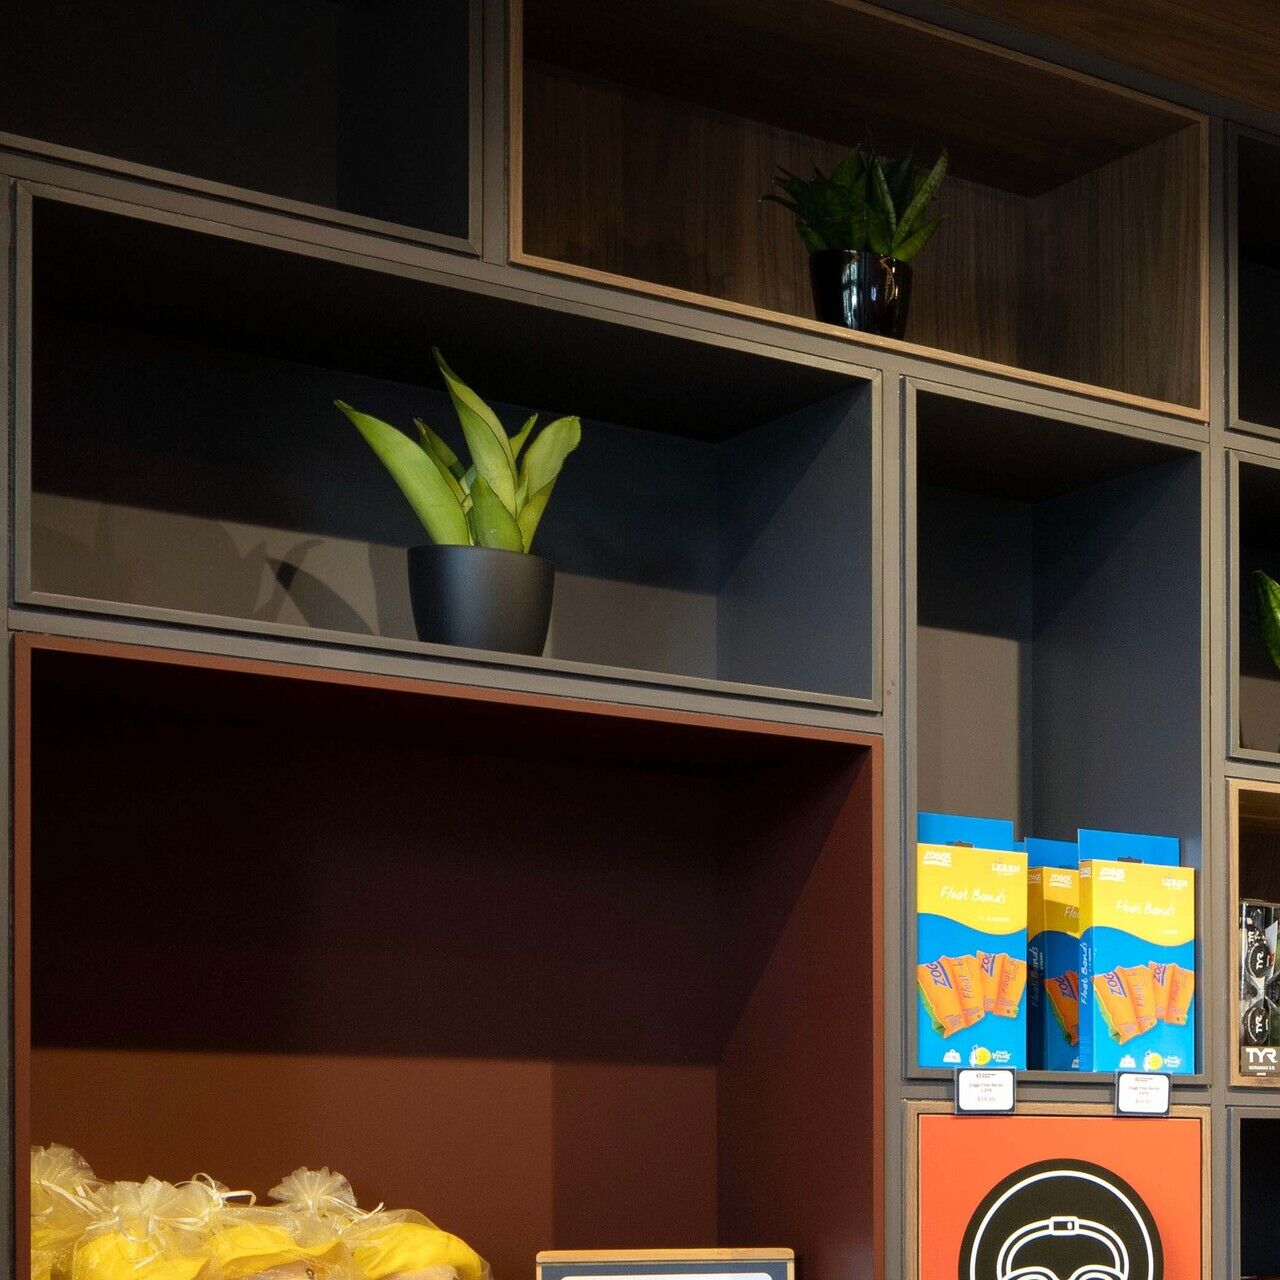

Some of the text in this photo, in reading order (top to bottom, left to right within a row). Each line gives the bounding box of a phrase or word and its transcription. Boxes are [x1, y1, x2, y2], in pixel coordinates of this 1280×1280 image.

[940, 886, 1006, 904] Float Bands
[1115, 900, 1175, 918] Float Bands
[1246, 1047, 1278, 1063] TYR
